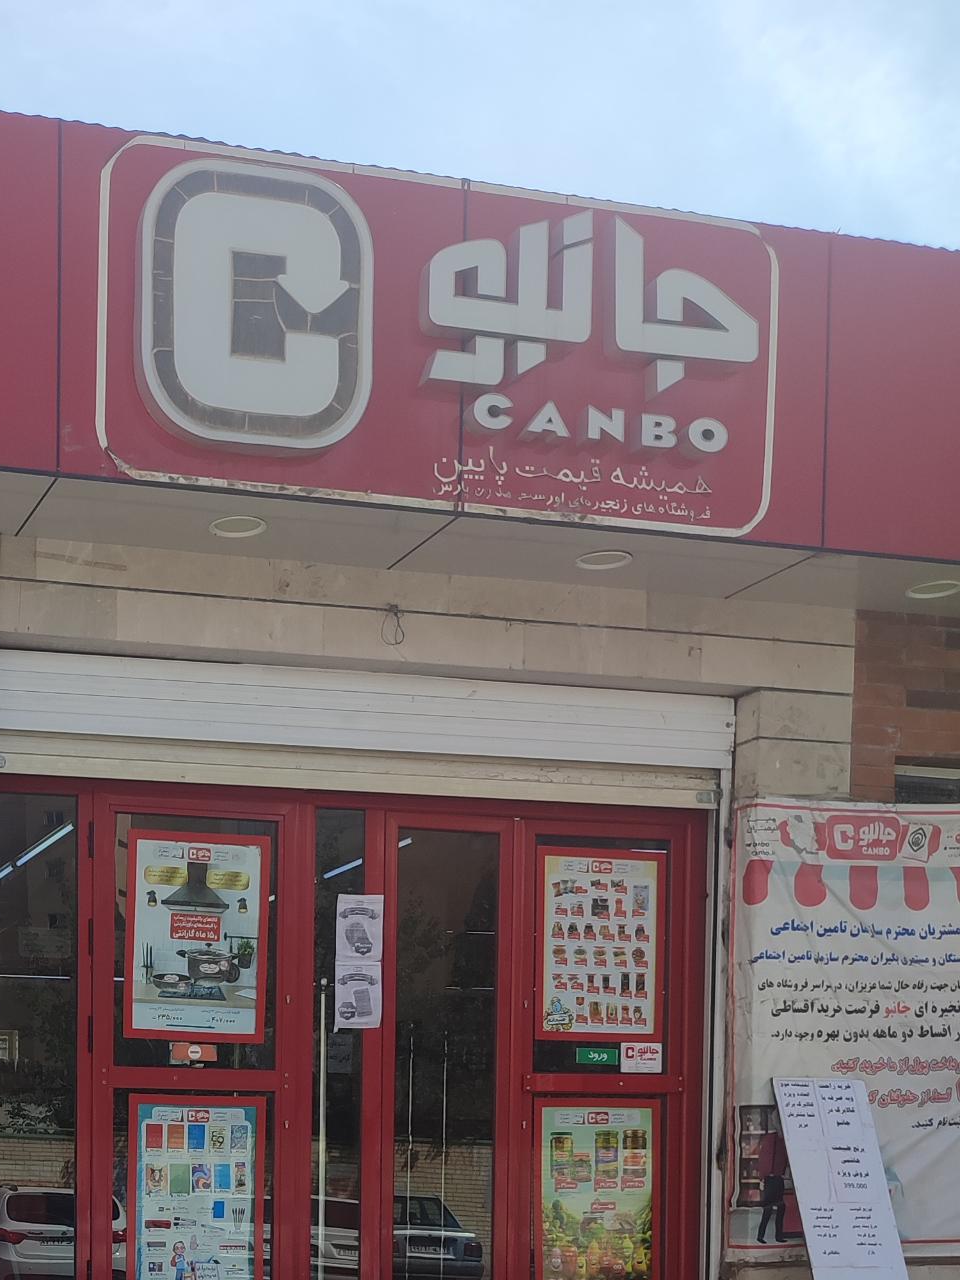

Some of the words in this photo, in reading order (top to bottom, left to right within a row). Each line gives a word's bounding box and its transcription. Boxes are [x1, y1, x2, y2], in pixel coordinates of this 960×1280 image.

[428, 208, 759, 394] جانبو
[473, 392, 729, 454] CANBO
[433, 446, 509, 486] پایین
[515, 458, 602, 492] قیمت
[610, 464, 713, 501] همیشه
[172, 928, 195, 939] گارانتی
[195, 930, 206, 938] ماه
[770, 918, 814, 936] اجتماعی
[816, 919, 848, 938] تامین
[850, 922, 883, 939] سازمان
[886, 926, 916, 941] محترم
[789, 950, 812, 964] تامین
[841, 953, 869, 966] محترم
[757, 978, 775, 991] های
[894, 979, 910, 993] حال
[912, 979, 928, 993] رفاه
[930, 980, 949, 992] جهت
[771, 1000, 815, 1018] اقساطی
[817, 1002, 843, 1018] خرید
[844, 1001, 880, 1019] فرصت
[883, 1001, 911, 1020] جانبو
[914, 1001, 928, 1018] ای
[816, 1028, 840, 1043] بهره
[842, 1026, 870, 1043] بدون
[872, 1025, 898, 1039] ماهه
[901, 1027, 914, 1043] دو
[917, 1024, 952, 1039] اقساط
[587, 1050, 608, 1062] ورود
